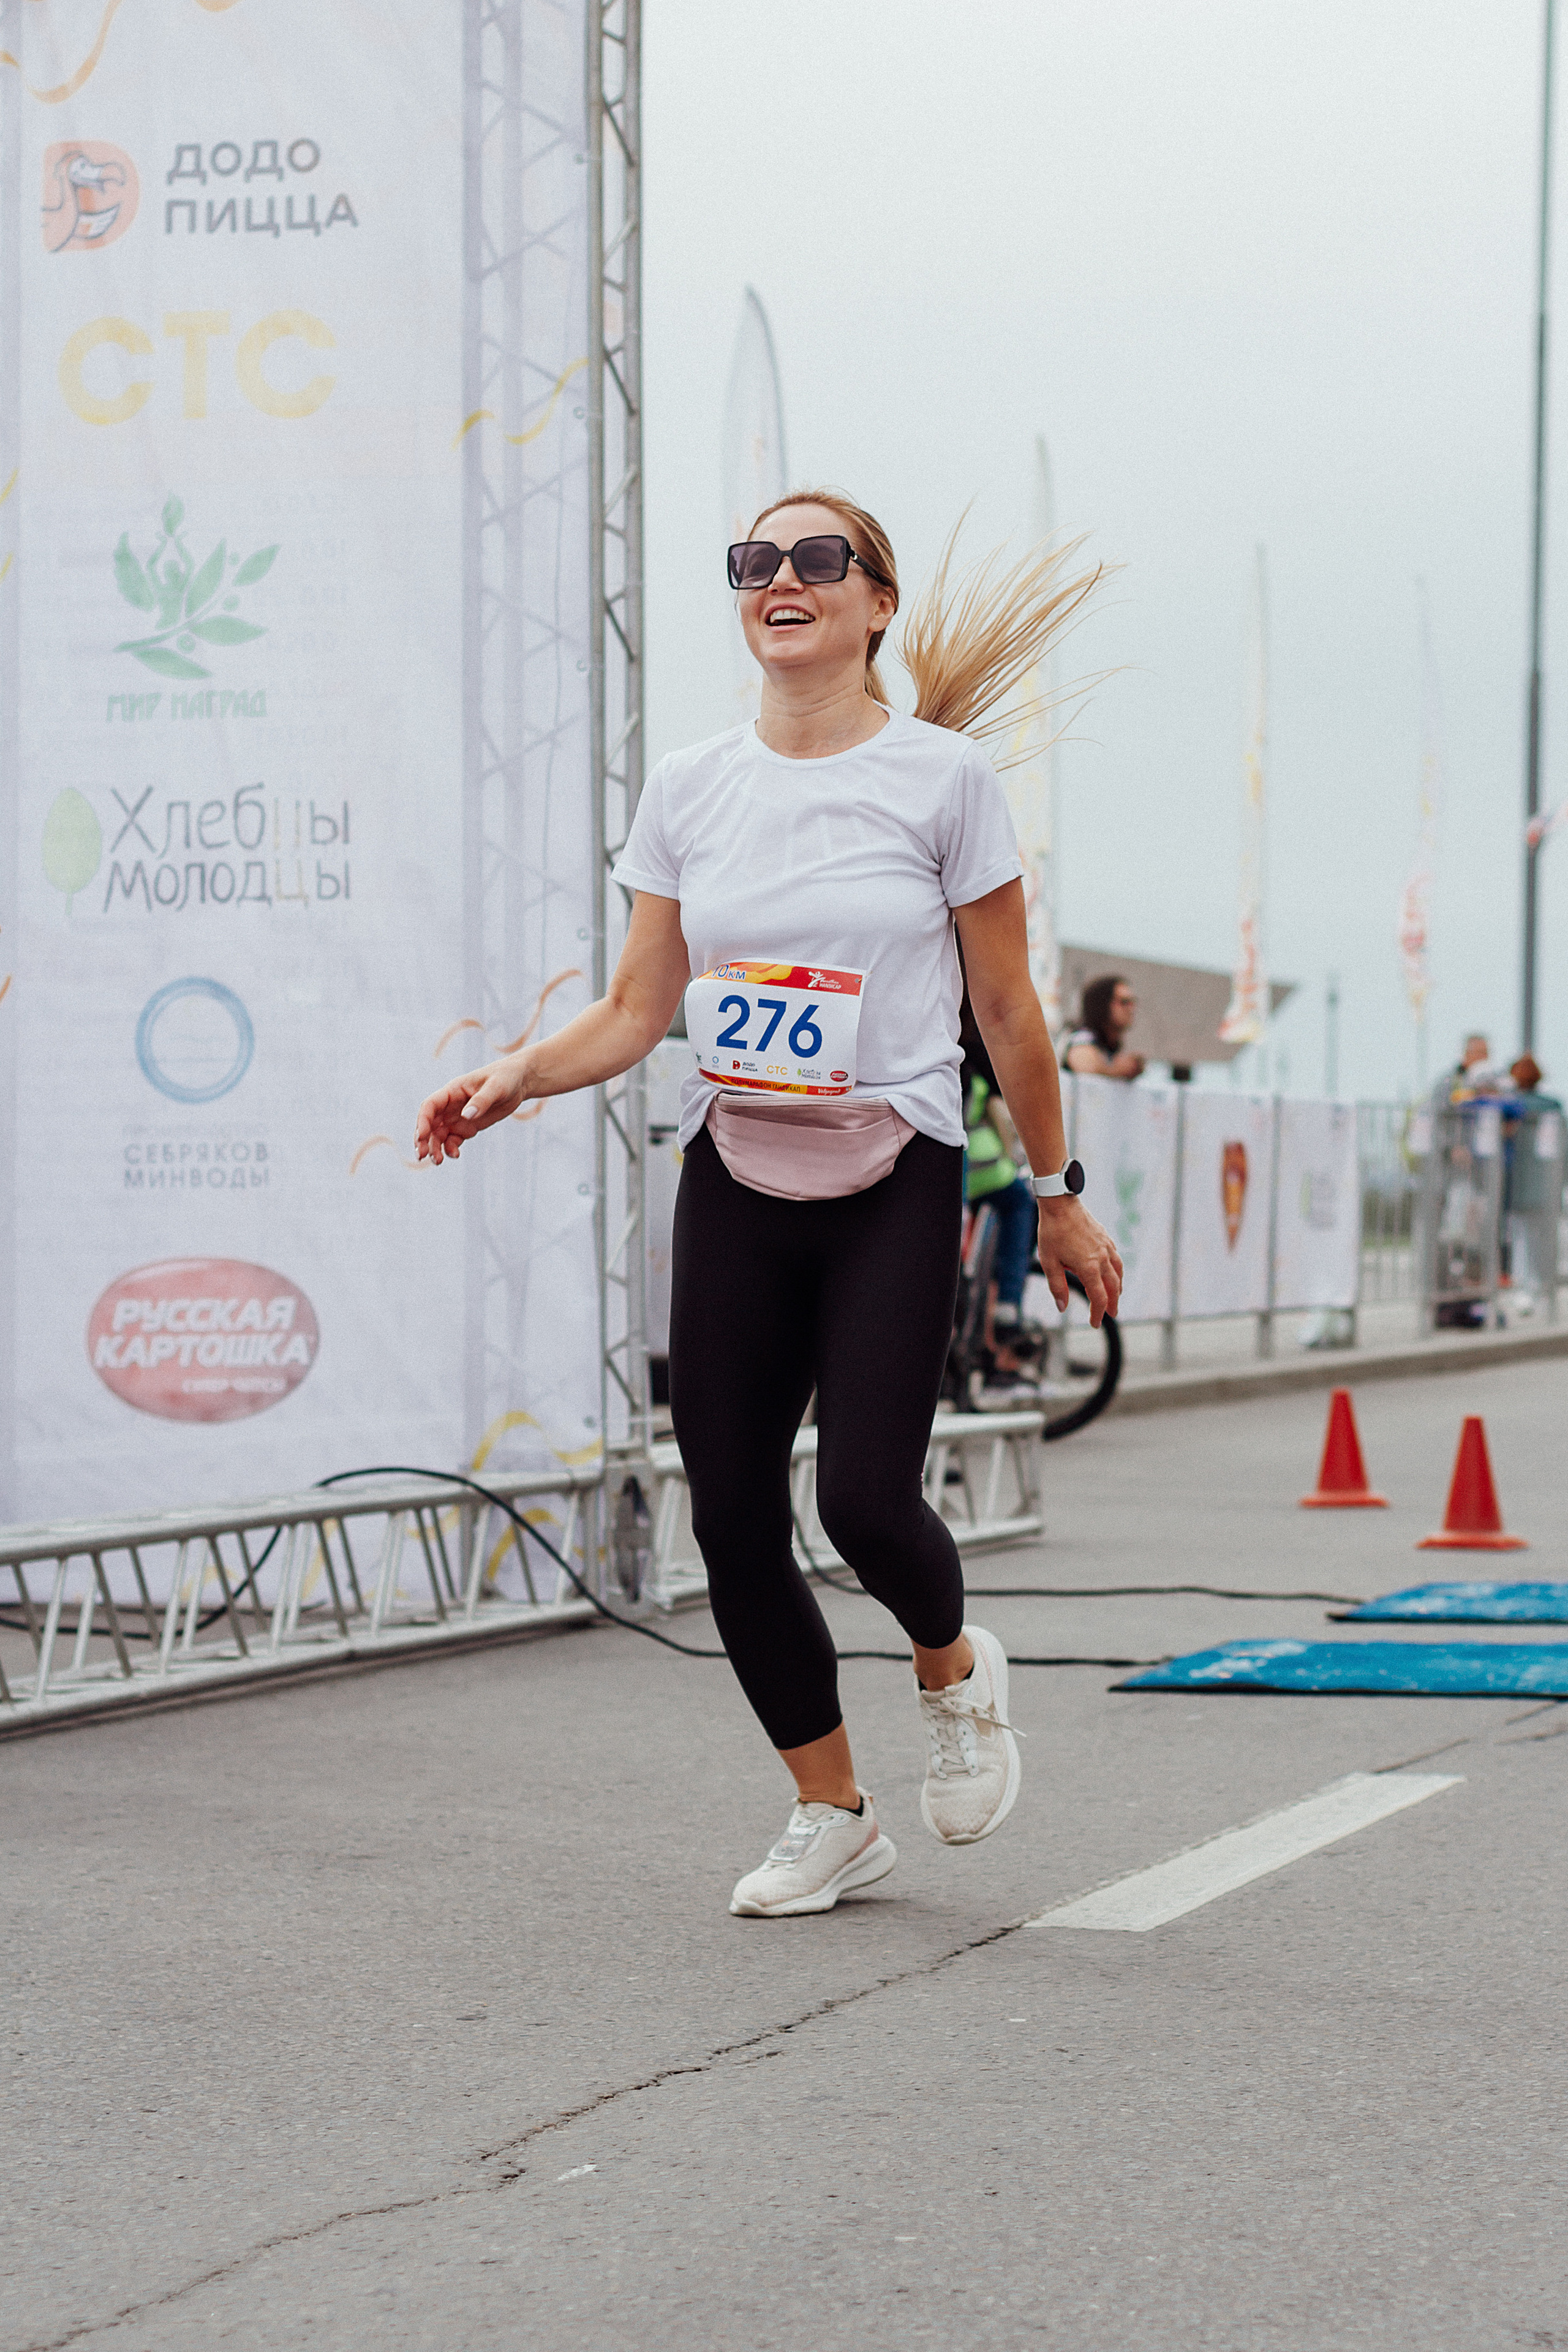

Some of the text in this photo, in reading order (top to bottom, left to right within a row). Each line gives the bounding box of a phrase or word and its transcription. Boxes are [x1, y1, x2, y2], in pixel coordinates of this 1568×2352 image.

[166, 138, 320, 184] ДОДО
[165, 193, 358, 238] ПИЦЦА
[59, 310, 337, 425] СТС
[107, 690, 267, 722] МИР НАГРАД
[103, 860, 350, 913] Молодцы
[716, 995, 823, 1058] 276
[766, 1065, 788, 1076] СТС
[772, 1084, 801, 1093] ГАНДИКАП
[124, 1142, 269, 1164] СЕБРЯКОВ
[124, 1166, 270, 1189] МИНВОДЫ
[113, 1295, 297, 1332] РУССКАЯ
[94, 1333, 309, 1368] КАРТОШКА
